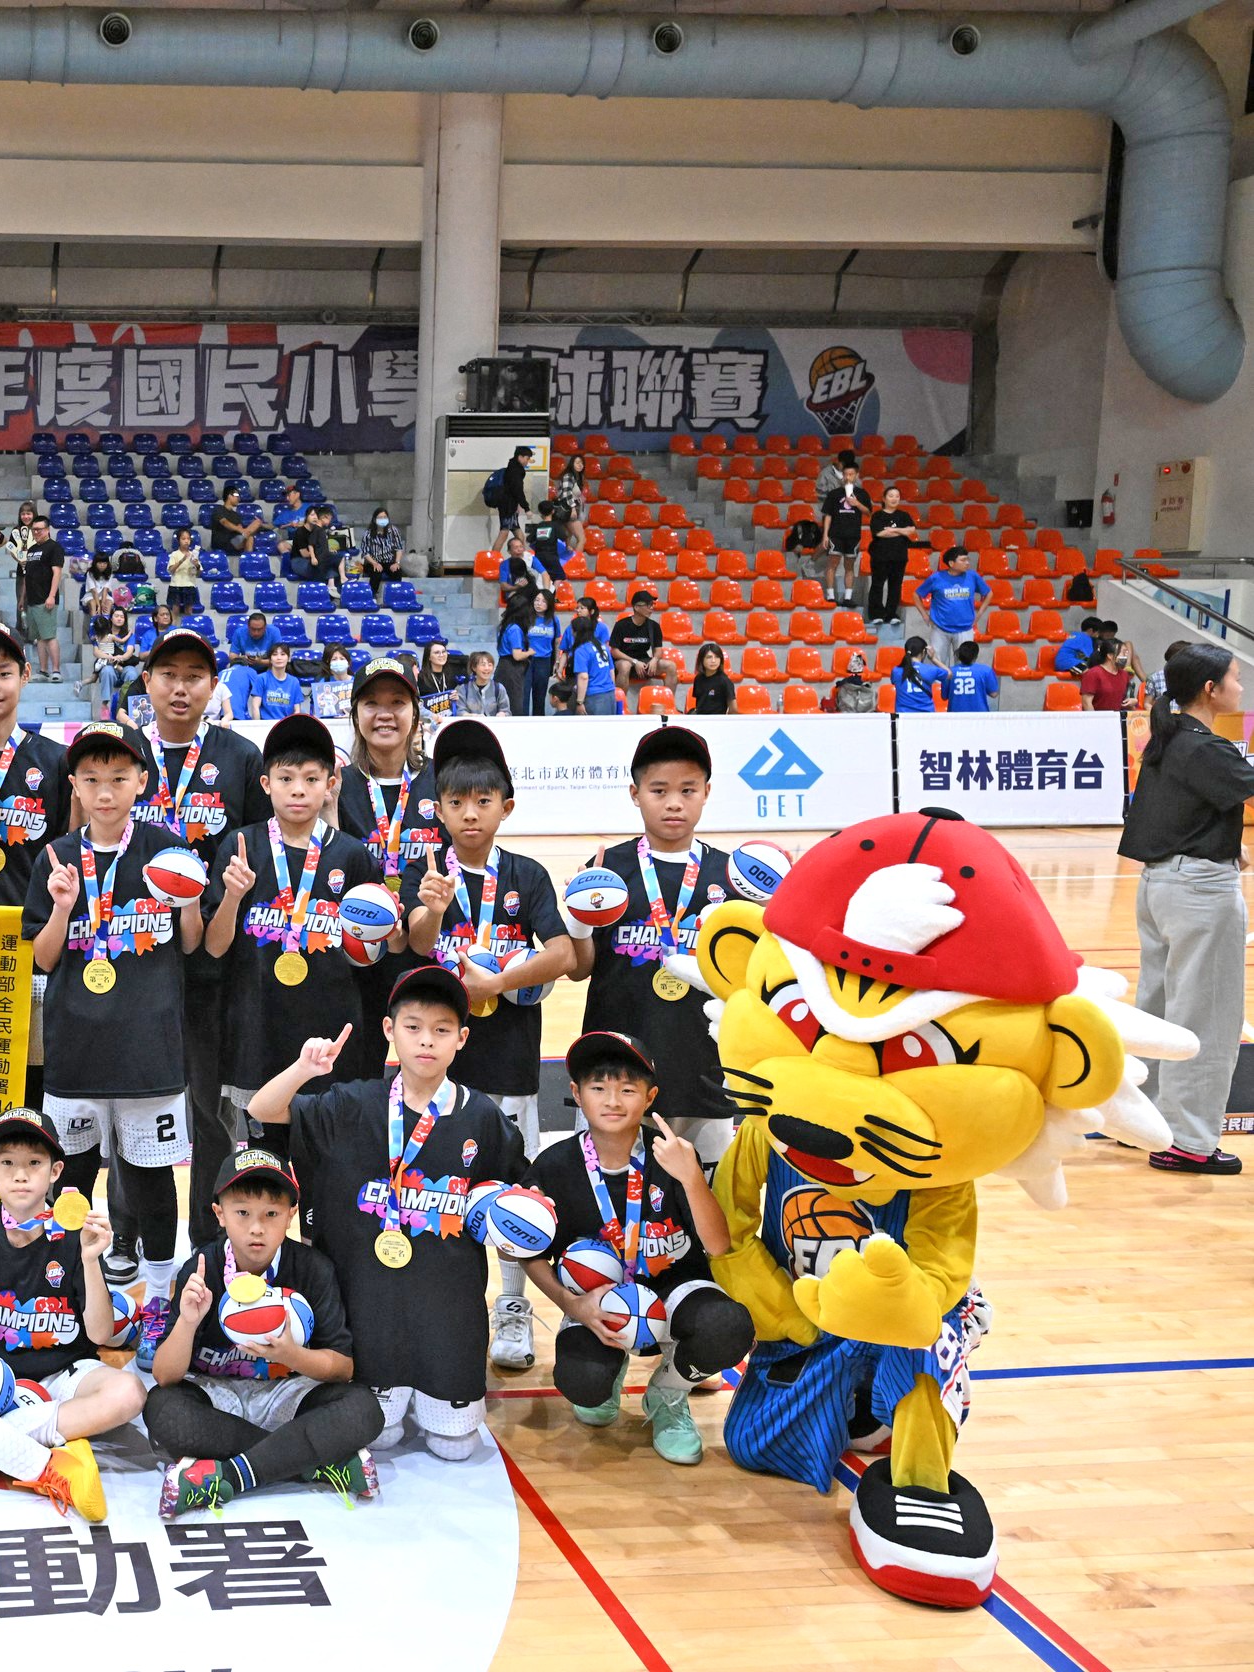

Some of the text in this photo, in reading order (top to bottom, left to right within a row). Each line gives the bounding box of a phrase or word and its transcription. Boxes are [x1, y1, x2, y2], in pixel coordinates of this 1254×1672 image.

[812, 359, 869, 405] EBL
[953, 678, 976, 695] 32
[920, 749, 1106, 791] 智林體育台
[757, 795, 807, 818] GET
[577, 874, 615, 885] conti
[748, 865, 777, 889] 1000
[344, 904, 379, 920] conti
[69, 1117, 95, 1130] LP
[156, 1113, 176, 1143] 2
[502, 1218, 543, 1247] conti
